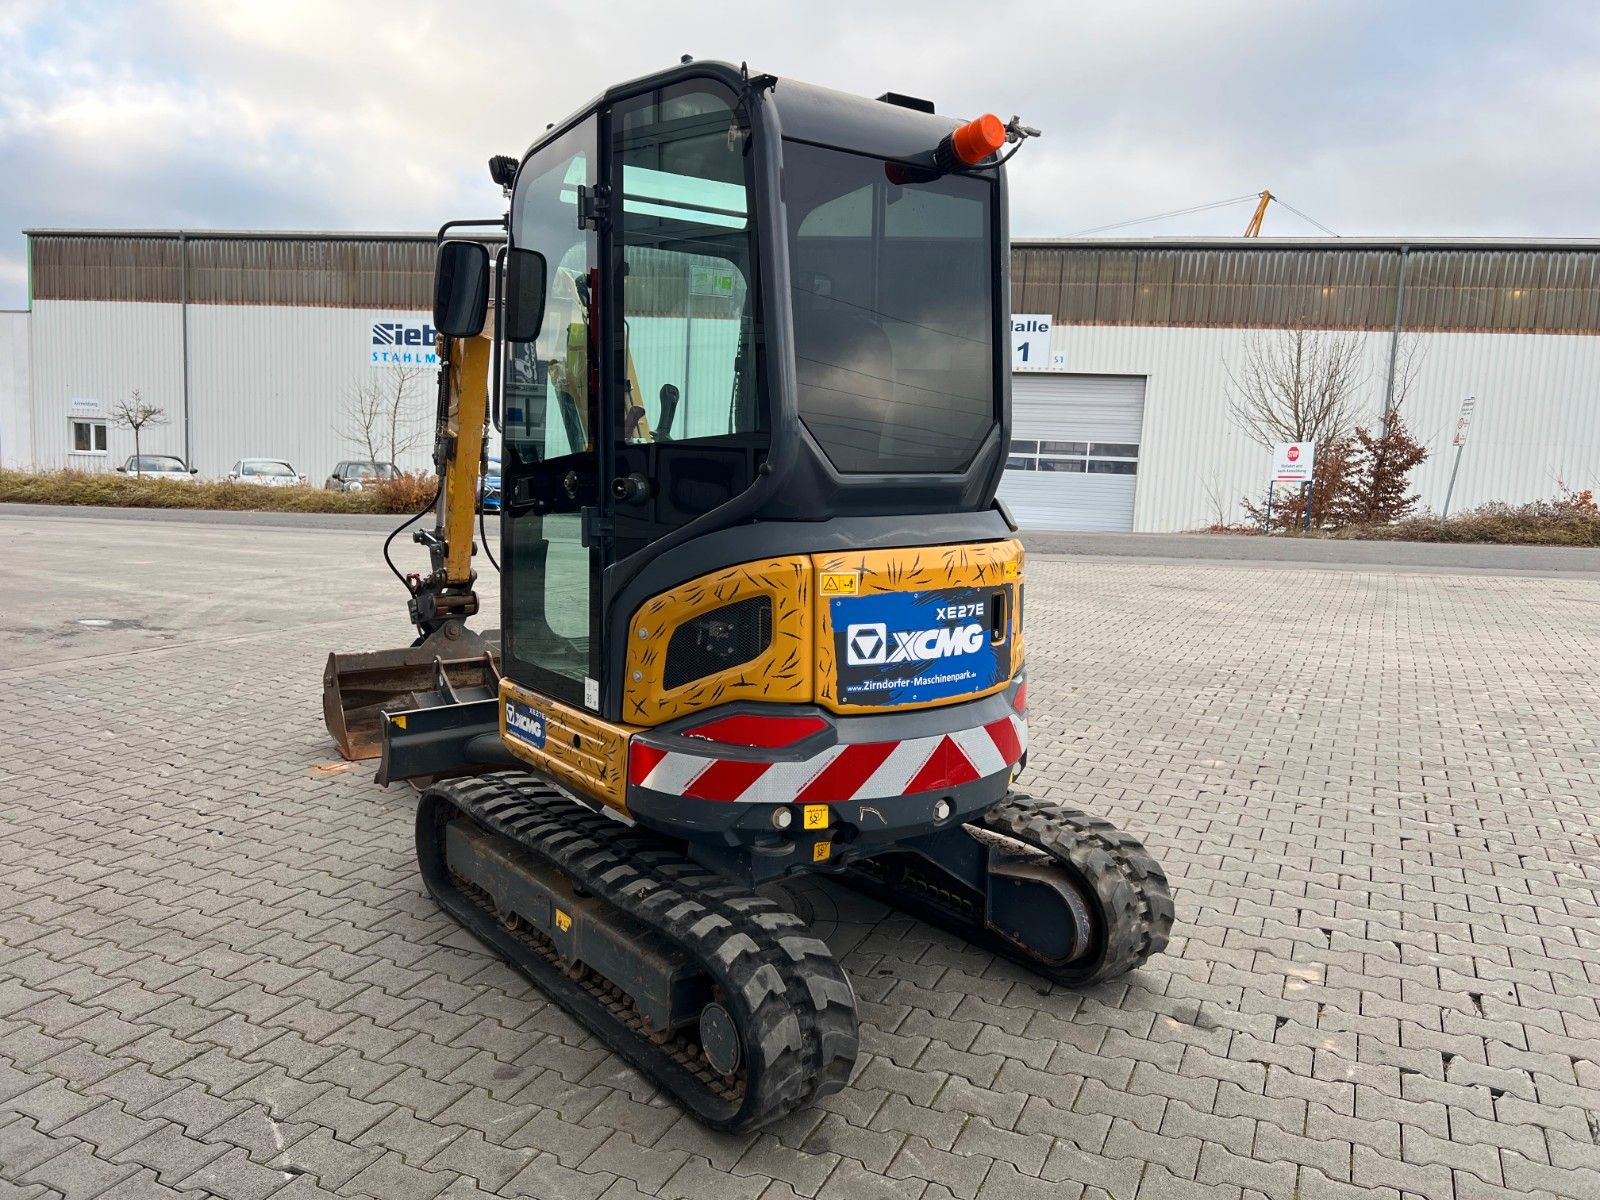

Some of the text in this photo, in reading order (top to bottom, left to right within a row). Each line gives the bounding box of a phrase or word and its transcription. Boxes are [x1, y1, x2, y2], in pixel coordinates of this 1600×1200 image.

[1011, 320, 1049, 332] alle
[1017, 342, 1029, 362] 1
[1288, 450, 1299, 458] STOP
[936, 602, 984, 621] XE27E
[886, 623, 984, 663] XCMG
[847, 670, 977, 692] www.Zirndorfer-Maschinenpark.de
[513, 712, 542, 738] XCMG
